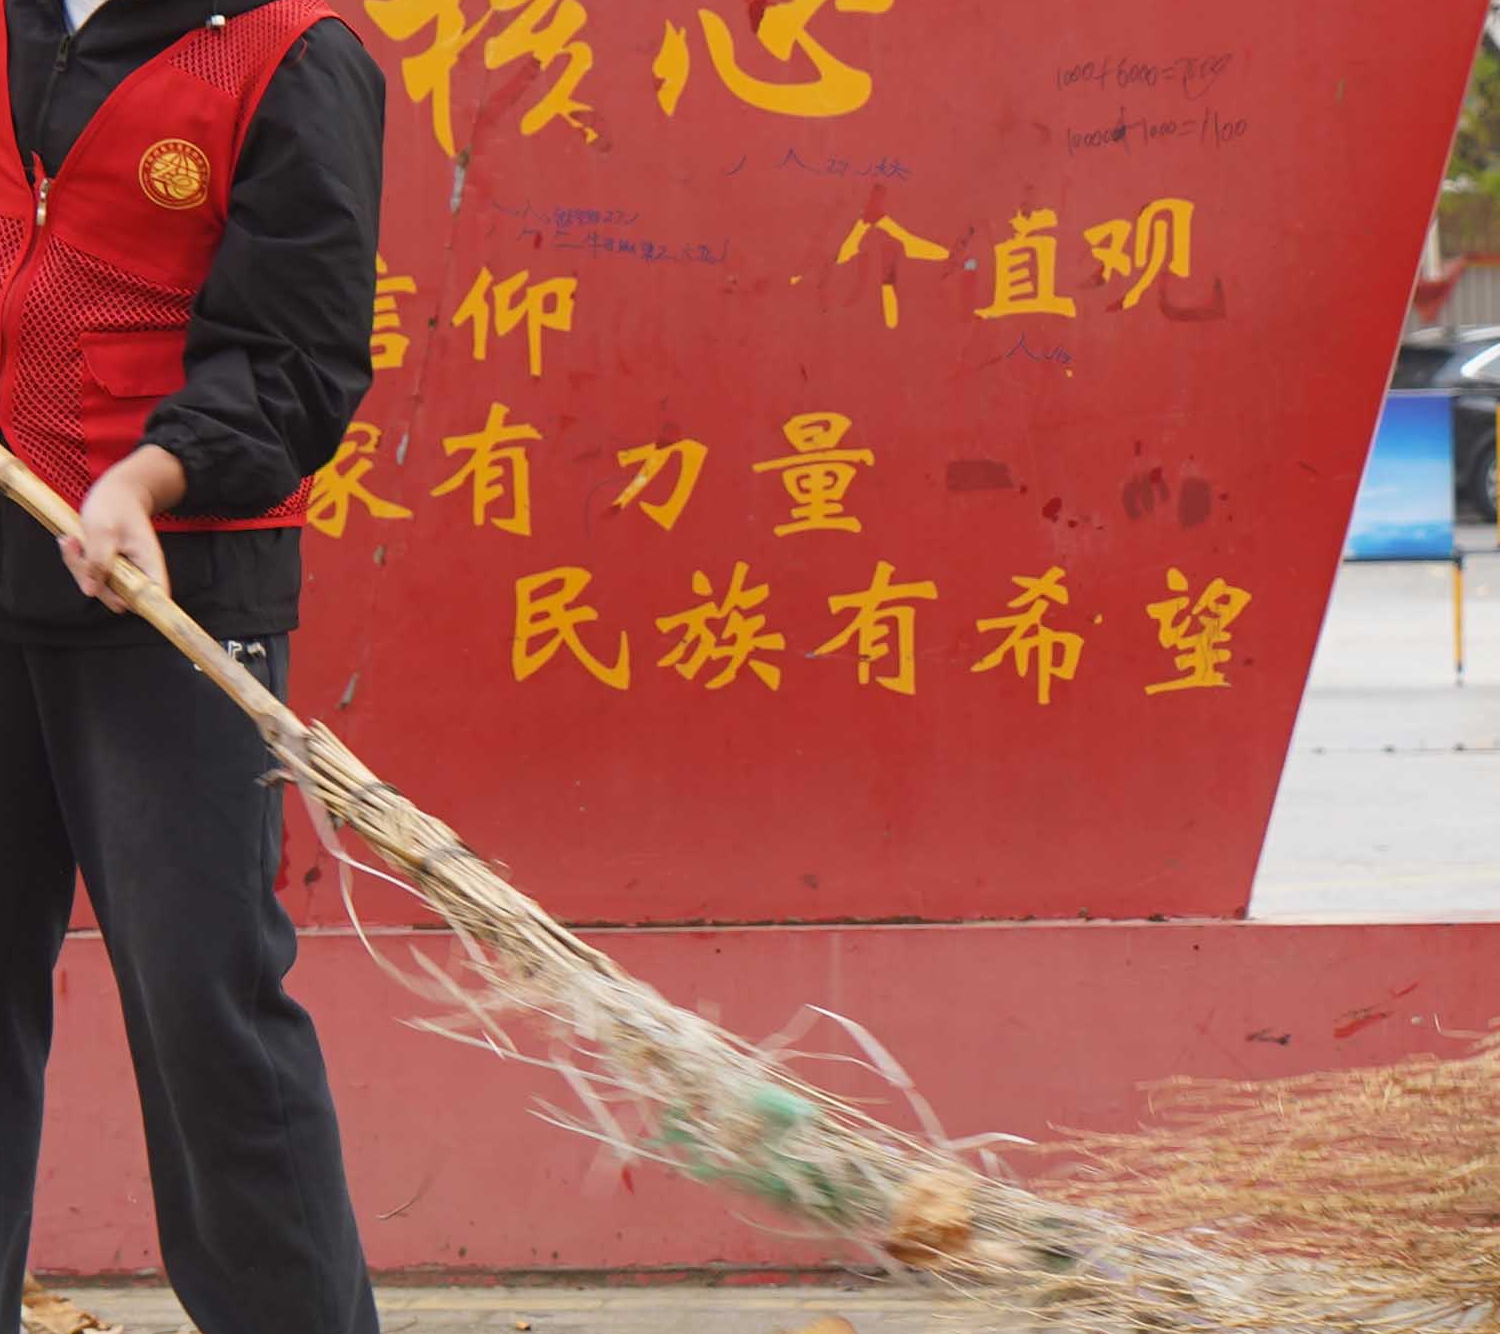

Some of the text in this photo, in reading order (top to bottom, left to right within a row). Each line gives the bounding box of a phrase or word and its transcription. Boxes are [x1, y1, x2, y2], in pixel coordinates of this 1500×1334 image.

[511, 560, 1252, 705] 民族有希望
